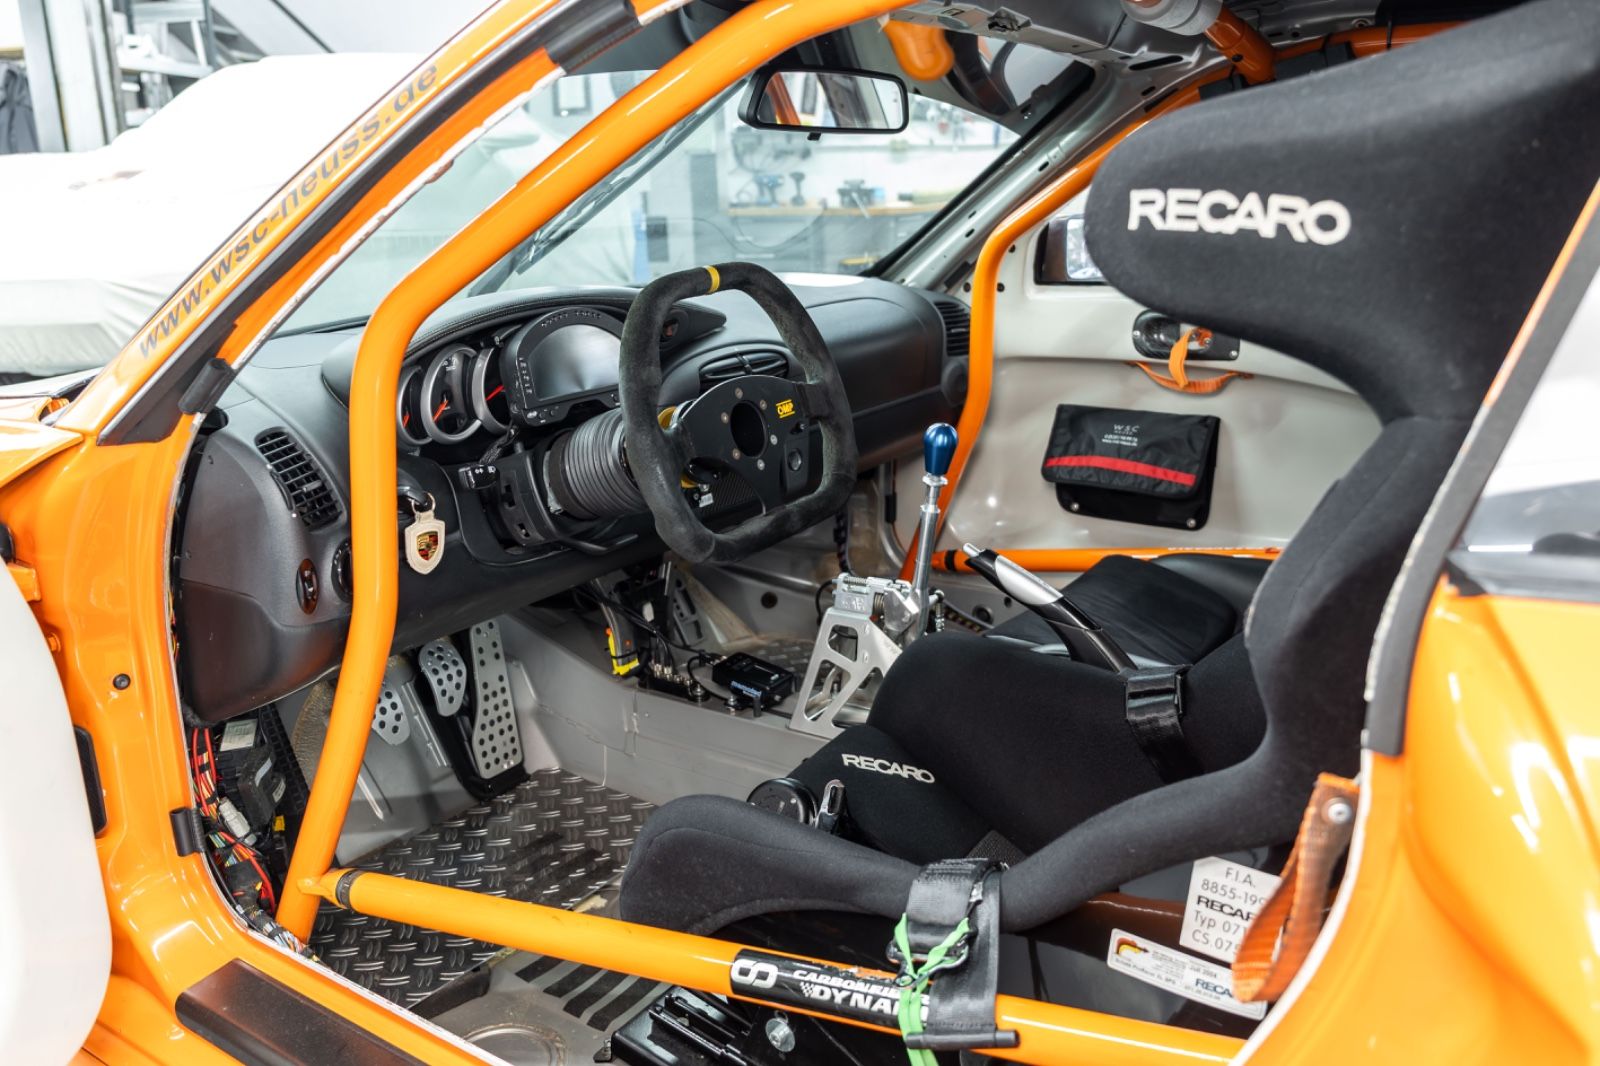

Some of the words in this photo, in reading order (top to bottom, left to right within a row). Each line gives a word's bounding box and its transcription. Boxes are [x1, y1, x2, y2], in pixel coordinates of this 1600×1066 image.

[138, 63, 438, 358] www.wsc-neuss.de
[1127, 188, 1352, 246] RECARO
[777, 401, 794, 416] OMP
[841, 753, 935, 784] RECARO
[1193, 910, 1217, 930] Typ
[1194, 977, 1235, 999] RECA
